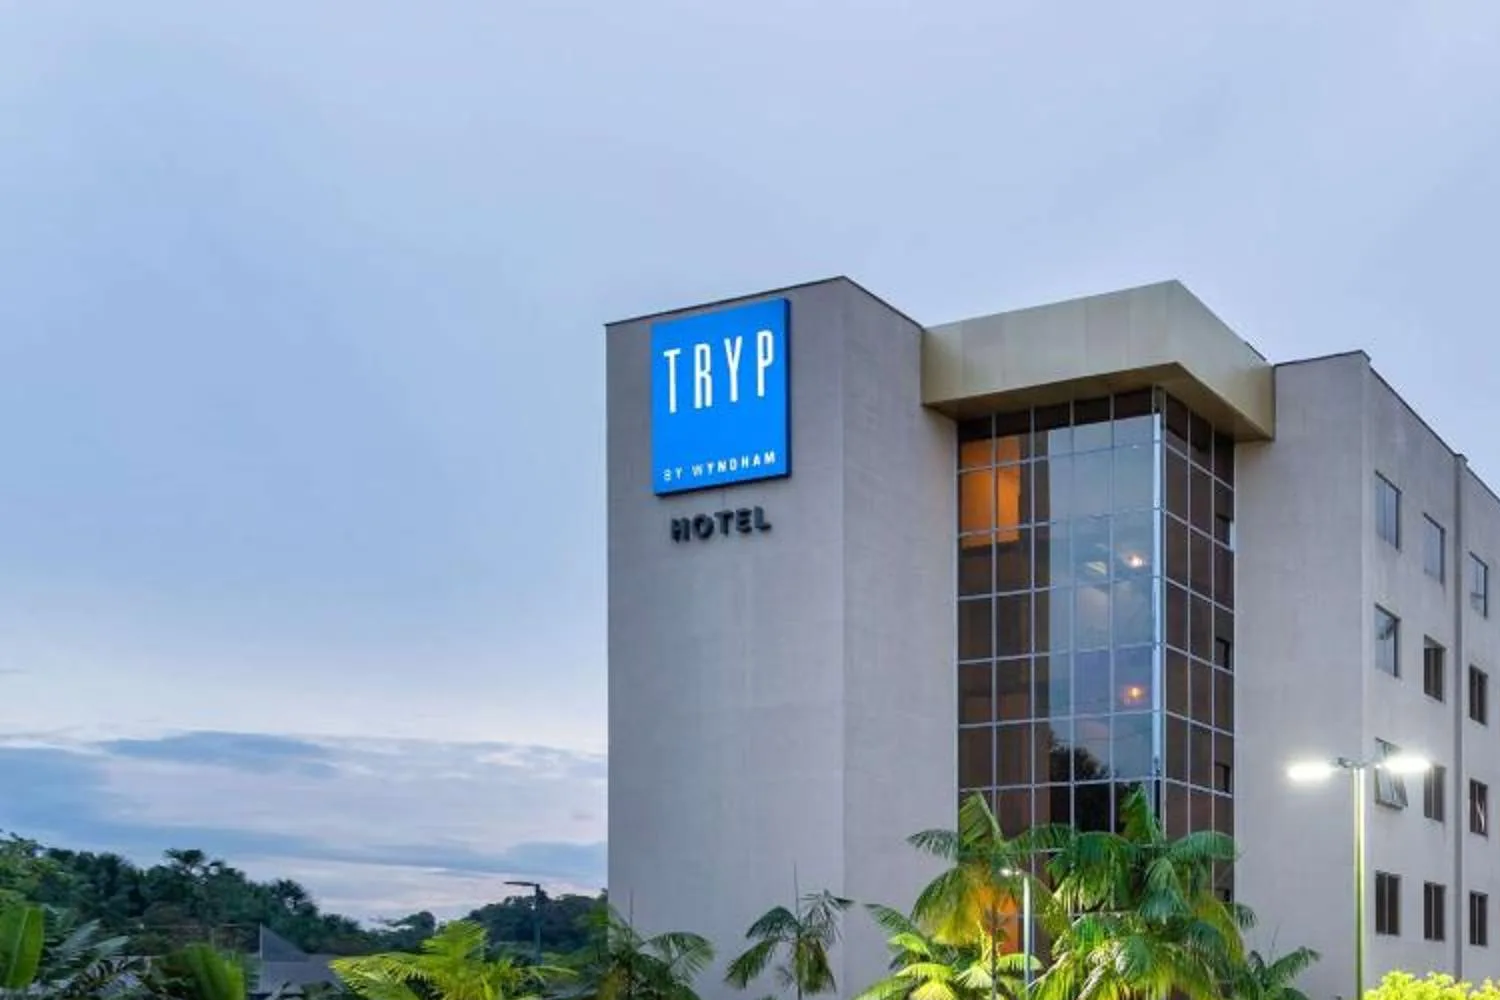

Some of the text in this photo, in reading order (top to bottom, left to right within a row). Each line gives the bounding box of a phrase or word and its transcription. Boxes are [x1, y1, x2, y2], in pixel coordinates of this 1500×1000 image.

[663, 329, 774, 415] TRYP
[663, 451, 776, 482] BY WYNDHAM
[670, 505, 772, 543] HOTEL
